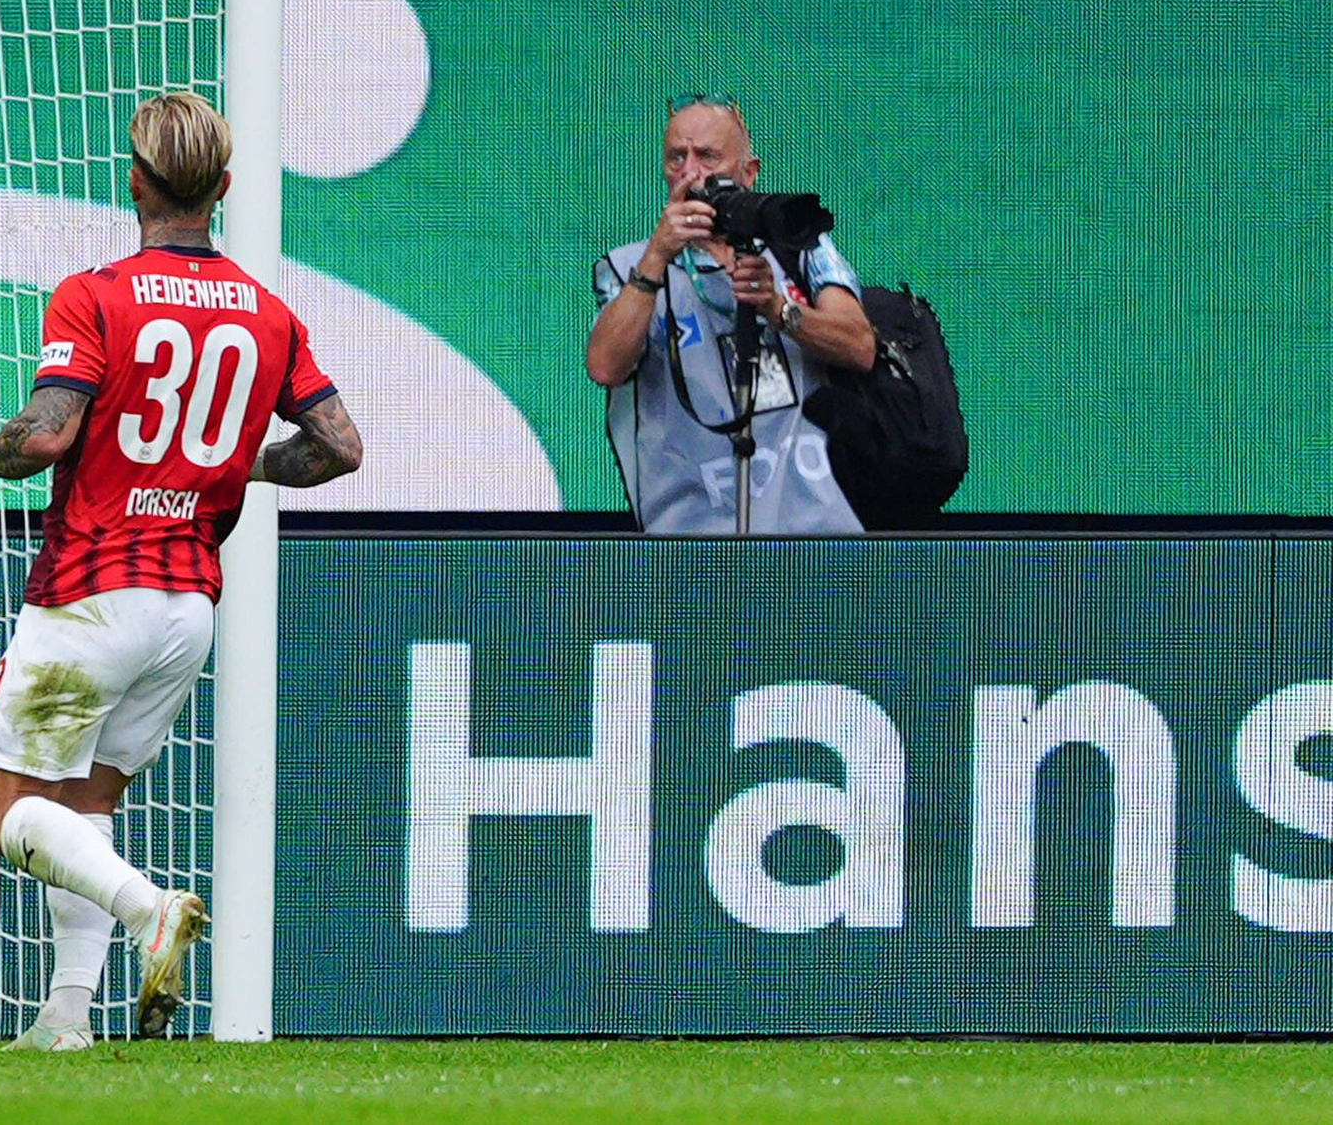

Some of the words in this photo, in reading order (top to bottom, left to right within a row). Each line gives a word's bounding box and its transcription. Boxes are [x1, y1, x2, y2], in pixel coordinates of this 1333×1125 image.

[131, 274, 259, 315] HEIDENHEIM
[117, 318, 260, 468] 30
[403, 639, 1333, 934] Hans
